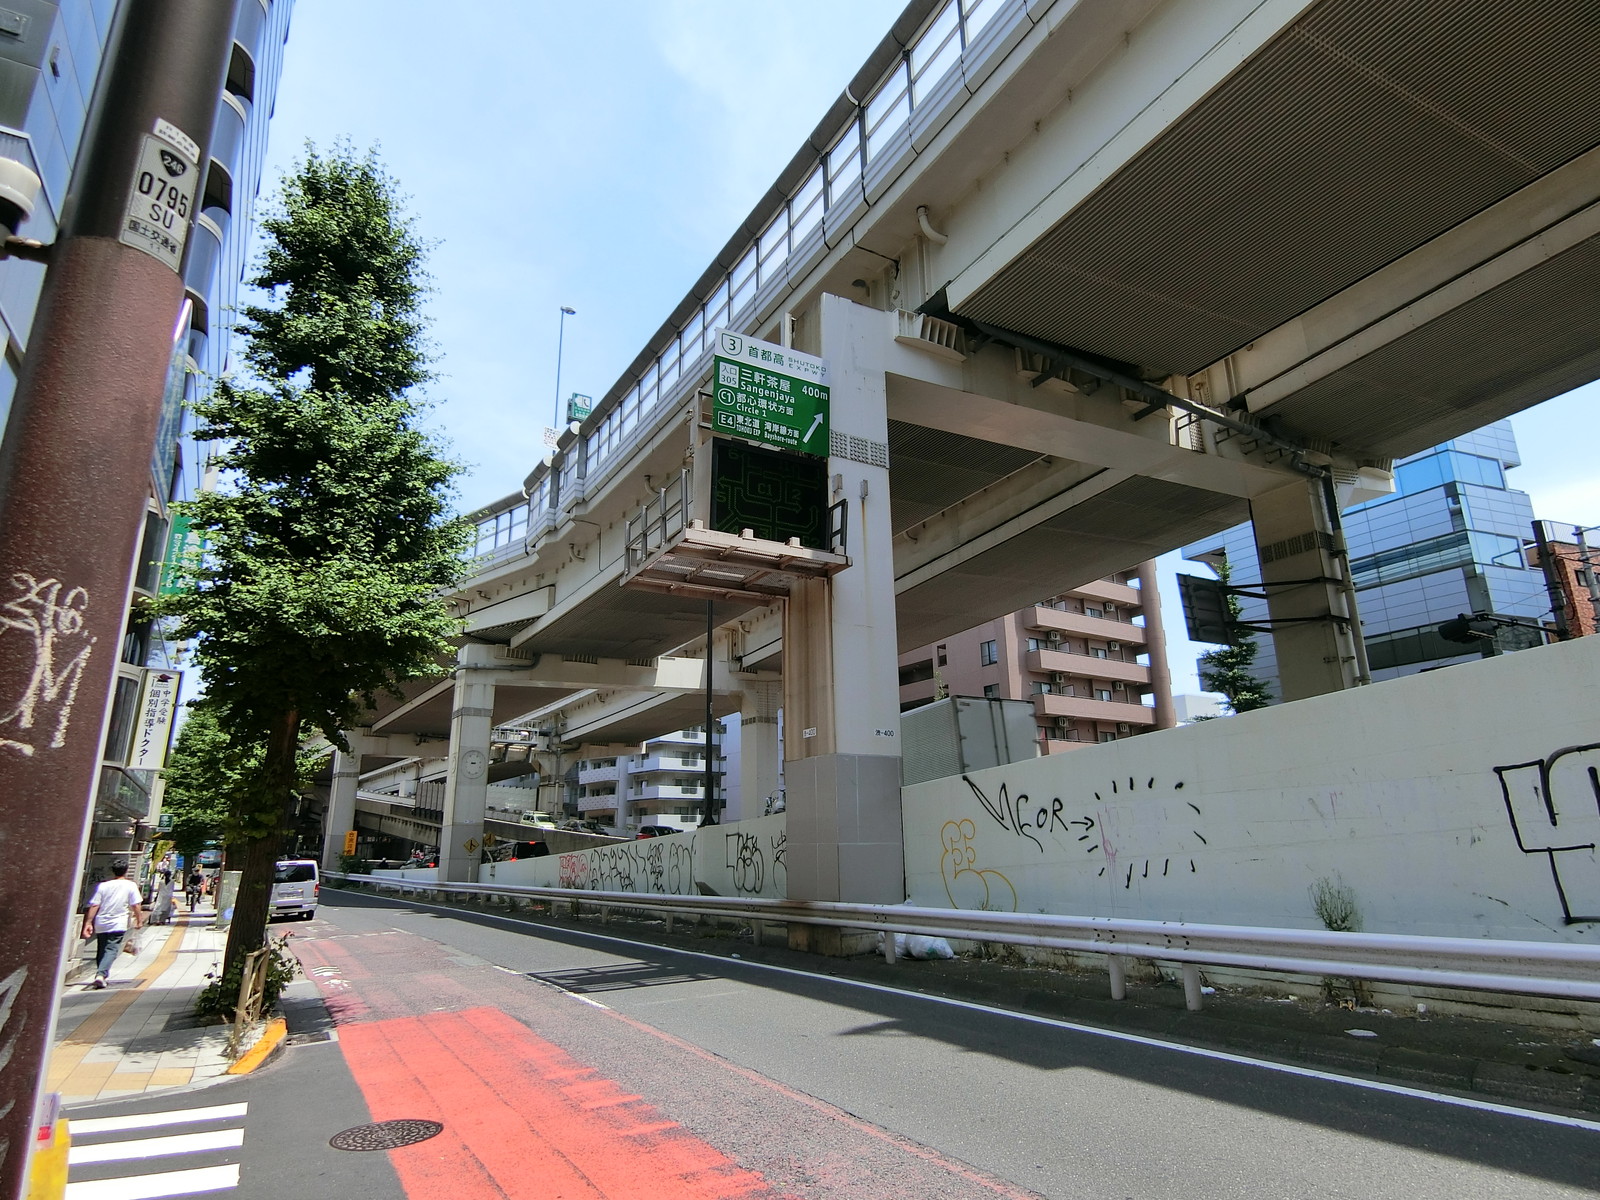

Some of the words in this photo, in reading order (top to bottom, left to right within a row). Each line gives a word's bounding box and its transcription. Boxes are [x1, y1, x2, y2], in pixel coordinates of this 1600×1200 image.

[163, 155, 184, 173] 246
[139, 171, 189, 219] 0795
[149, 203, 175, 230] SU
[128, 219, 178, 255] 国土交通省
[728, 338, 736, 351] 3
[748, 345, 784, 367] 首都高
[721, 364, 738, 376] 入口
[788, 357, 827, 373] SHUTOKO
[721, 375, 737, 386] 305
[740, 368, 792, 393] 三軒茶屋
[720, 391, 732, 403] C1
[740, 381, 796, 405] Sangenjaya
[801, 385, 829, 401] 400m
[736, 392, 795, 417] 都心環状方面
[736, 403, 760, 416] Circle
[762, 409, 767, 418] 1
[720, 414, 734, 426] E4
[736, 414, 760, 429] 東北道
[757, 482, 773, 497] C1
[791, 489, 802, 501] 2
[156, 689, 172, 725] 中学受験
[139, 688, 161, 766] 個別指導ドクター
